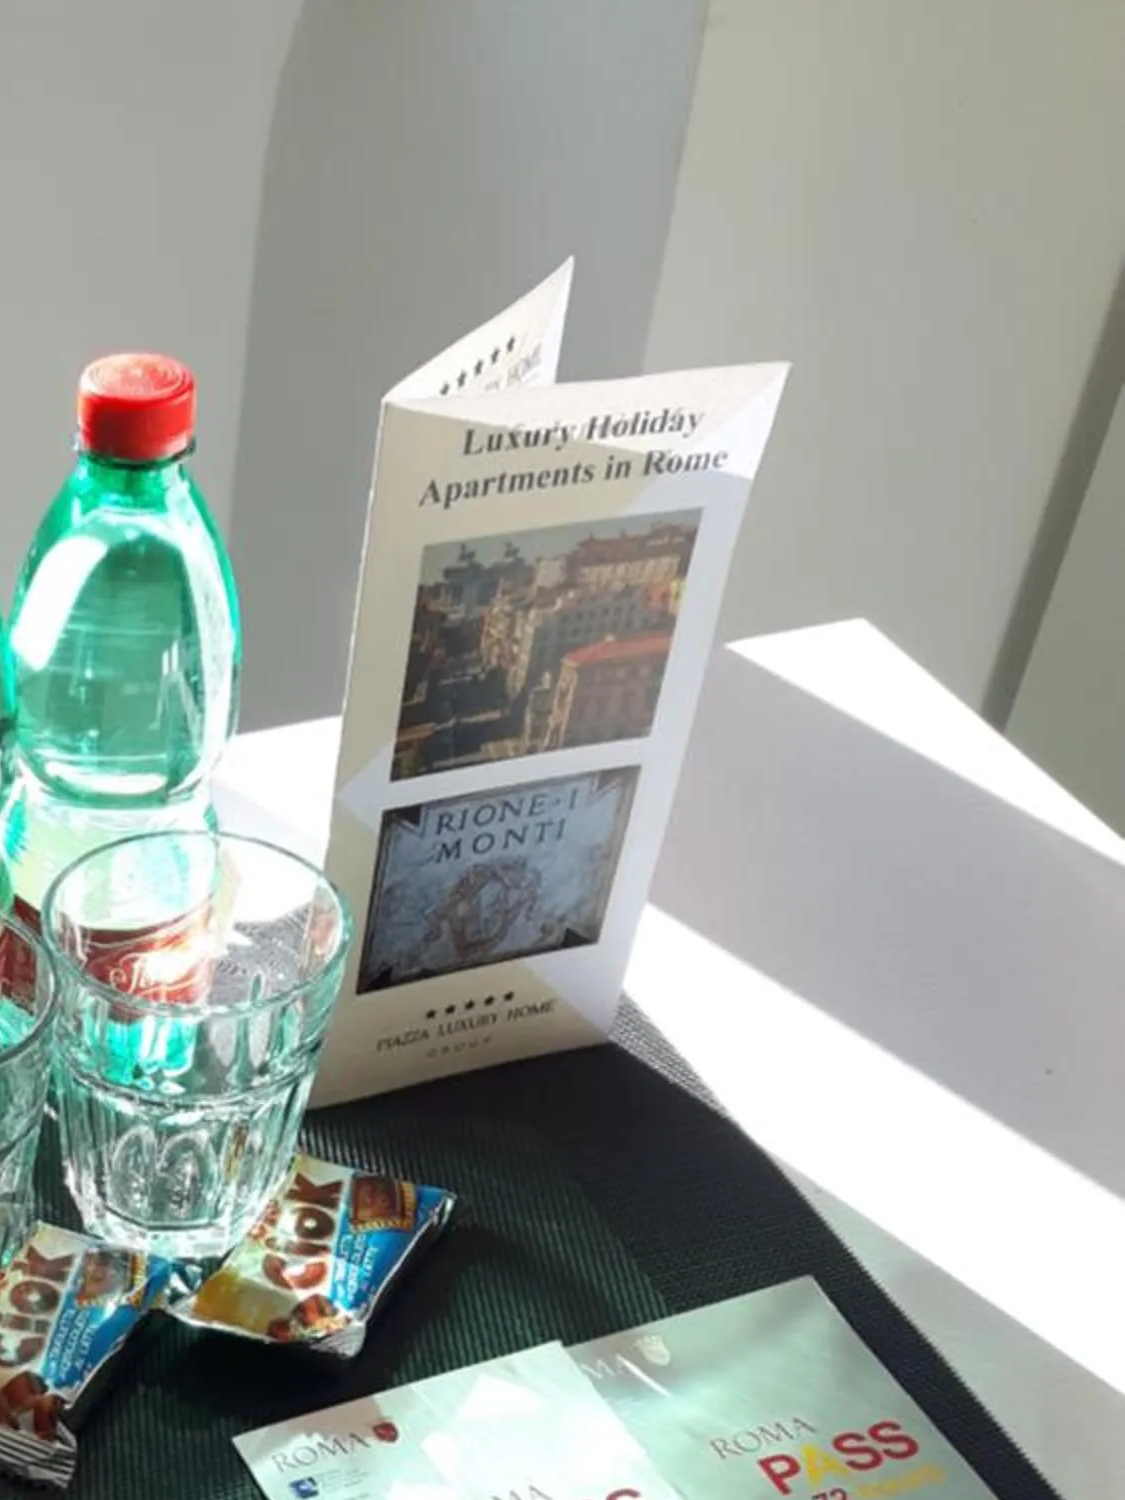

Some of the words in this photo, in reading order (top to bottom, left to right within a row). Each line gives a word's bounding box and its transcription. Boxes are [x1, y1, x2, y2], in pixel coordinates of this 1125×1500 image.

[463, 421, 575, 455] Luxury
[586, 407, 705, 441] Holiday
[419, 461, 595, 509] Apartments
[604, 454, 631, 480] in
[642, 449, 728, 477] Rome
[435, 796, 547, 835] RIONE
[434, 818, 566, 864] MONTI
[437, 1013, 499, 1038] LUXURY
[507, 1001, 555, 1021] HOME
[271, 1431, 372, 1473] ROMA
[709, 1416, 818, 1460] ROMA
[757, 1420, 919, 1496] PASS
